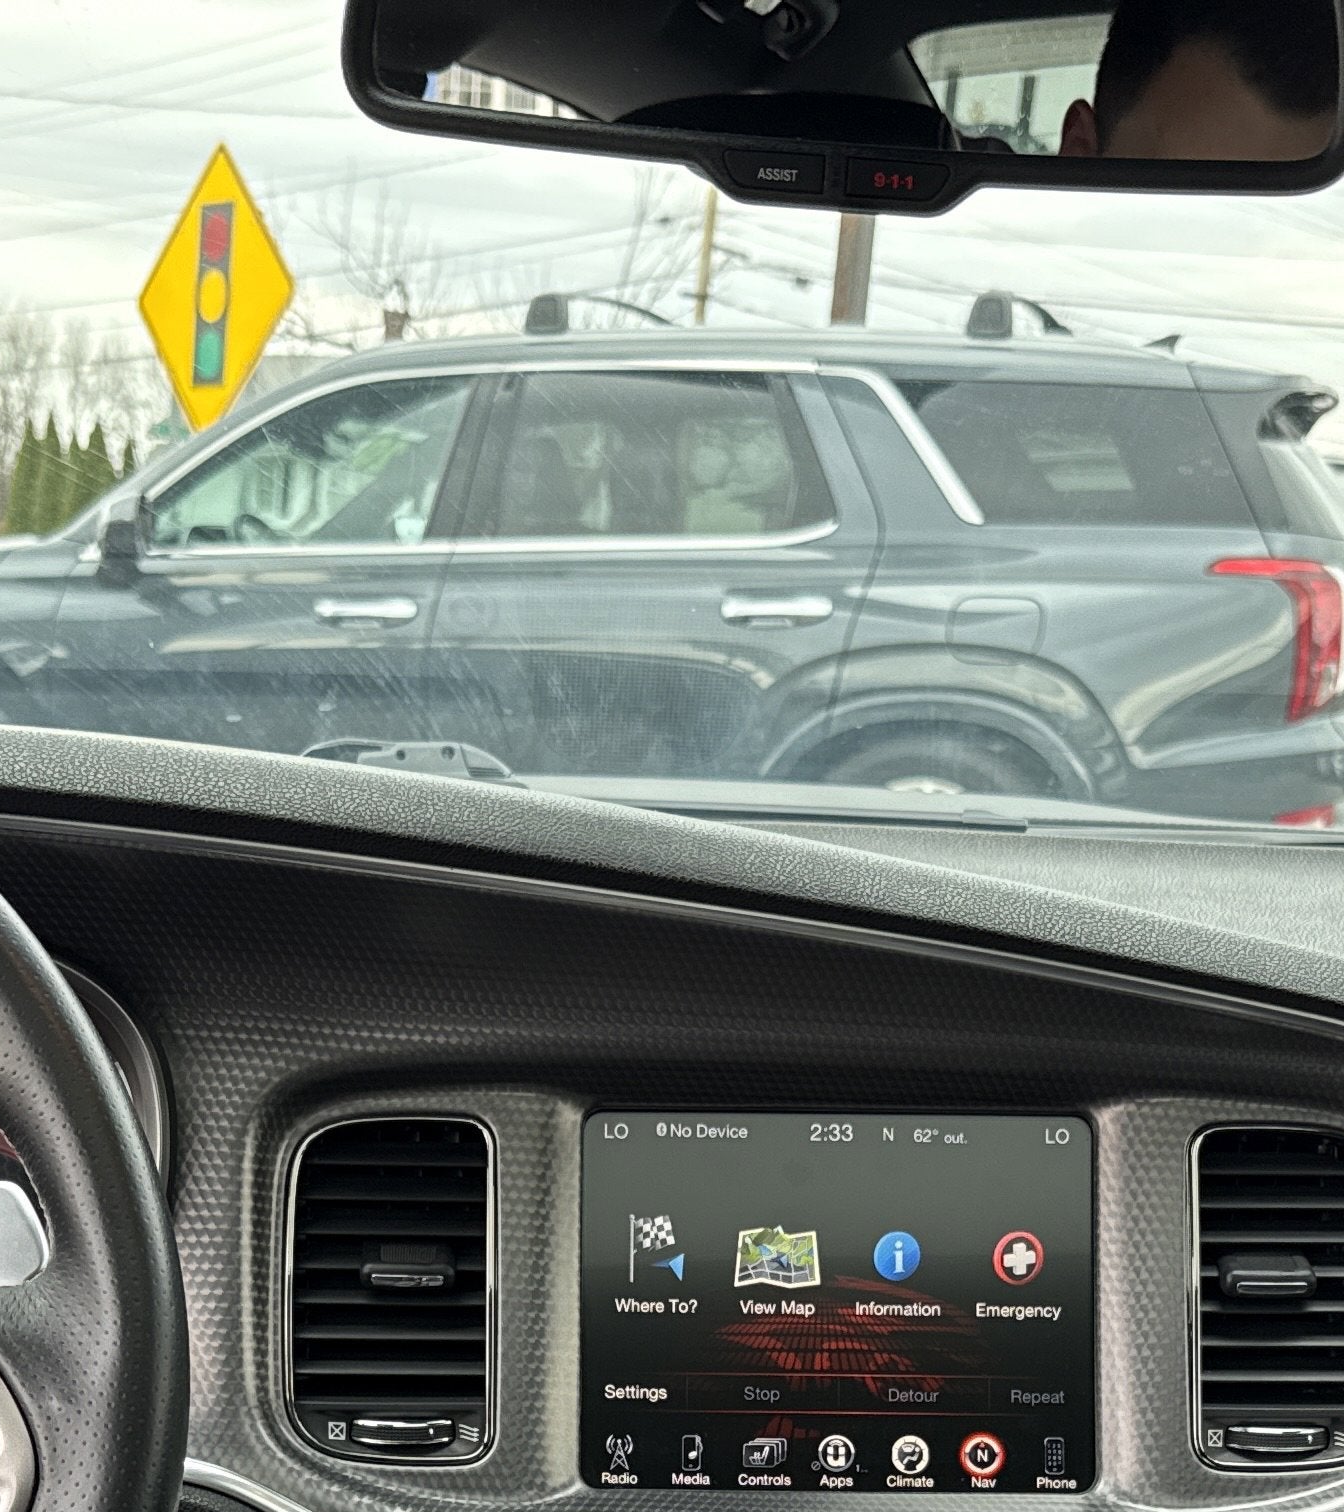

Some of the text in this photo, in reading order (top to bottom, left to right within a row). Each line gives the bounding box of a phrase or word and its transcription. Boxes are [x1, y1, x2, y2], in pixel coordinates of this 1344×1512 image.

[758, 168, 798, 181] ASSIST
[605, 1123, 628, 1139] LO
[671, 1124, 748, 1138] No Device
[811, 1124, 853, 1141] 2:33
[883, 1128, 893, 1141] N
[914, 1129, 967, 1143] 62° out.
[1046, 1129, 1069, 1144] LO
[615, 1298, 697, 1313] Where To?
[740, 1300, 815, 1318] View Map
[856, 1301, 940, 1320] Information
[976, 1303, 1061, 1320] Emergency
[605, 1384, 667, 1402] Settings
[744, 1387, 780, 1403] Stop
[889, 1386, 939, 1402] Detour
[1011, 1390, 1064, 1406] Repeat
[602, 1472, 637, 1484] Radio
[672, 1473, 710, 1485] Media
[738, 1474, 791, 1485] Controls
[820, 1475, 853, 1488] Apps
[887, 1473, 934, 1487] Climate
[971, 1473, 996, 1488] Nav
[1037, 1477, 1076, 1489] Phone
